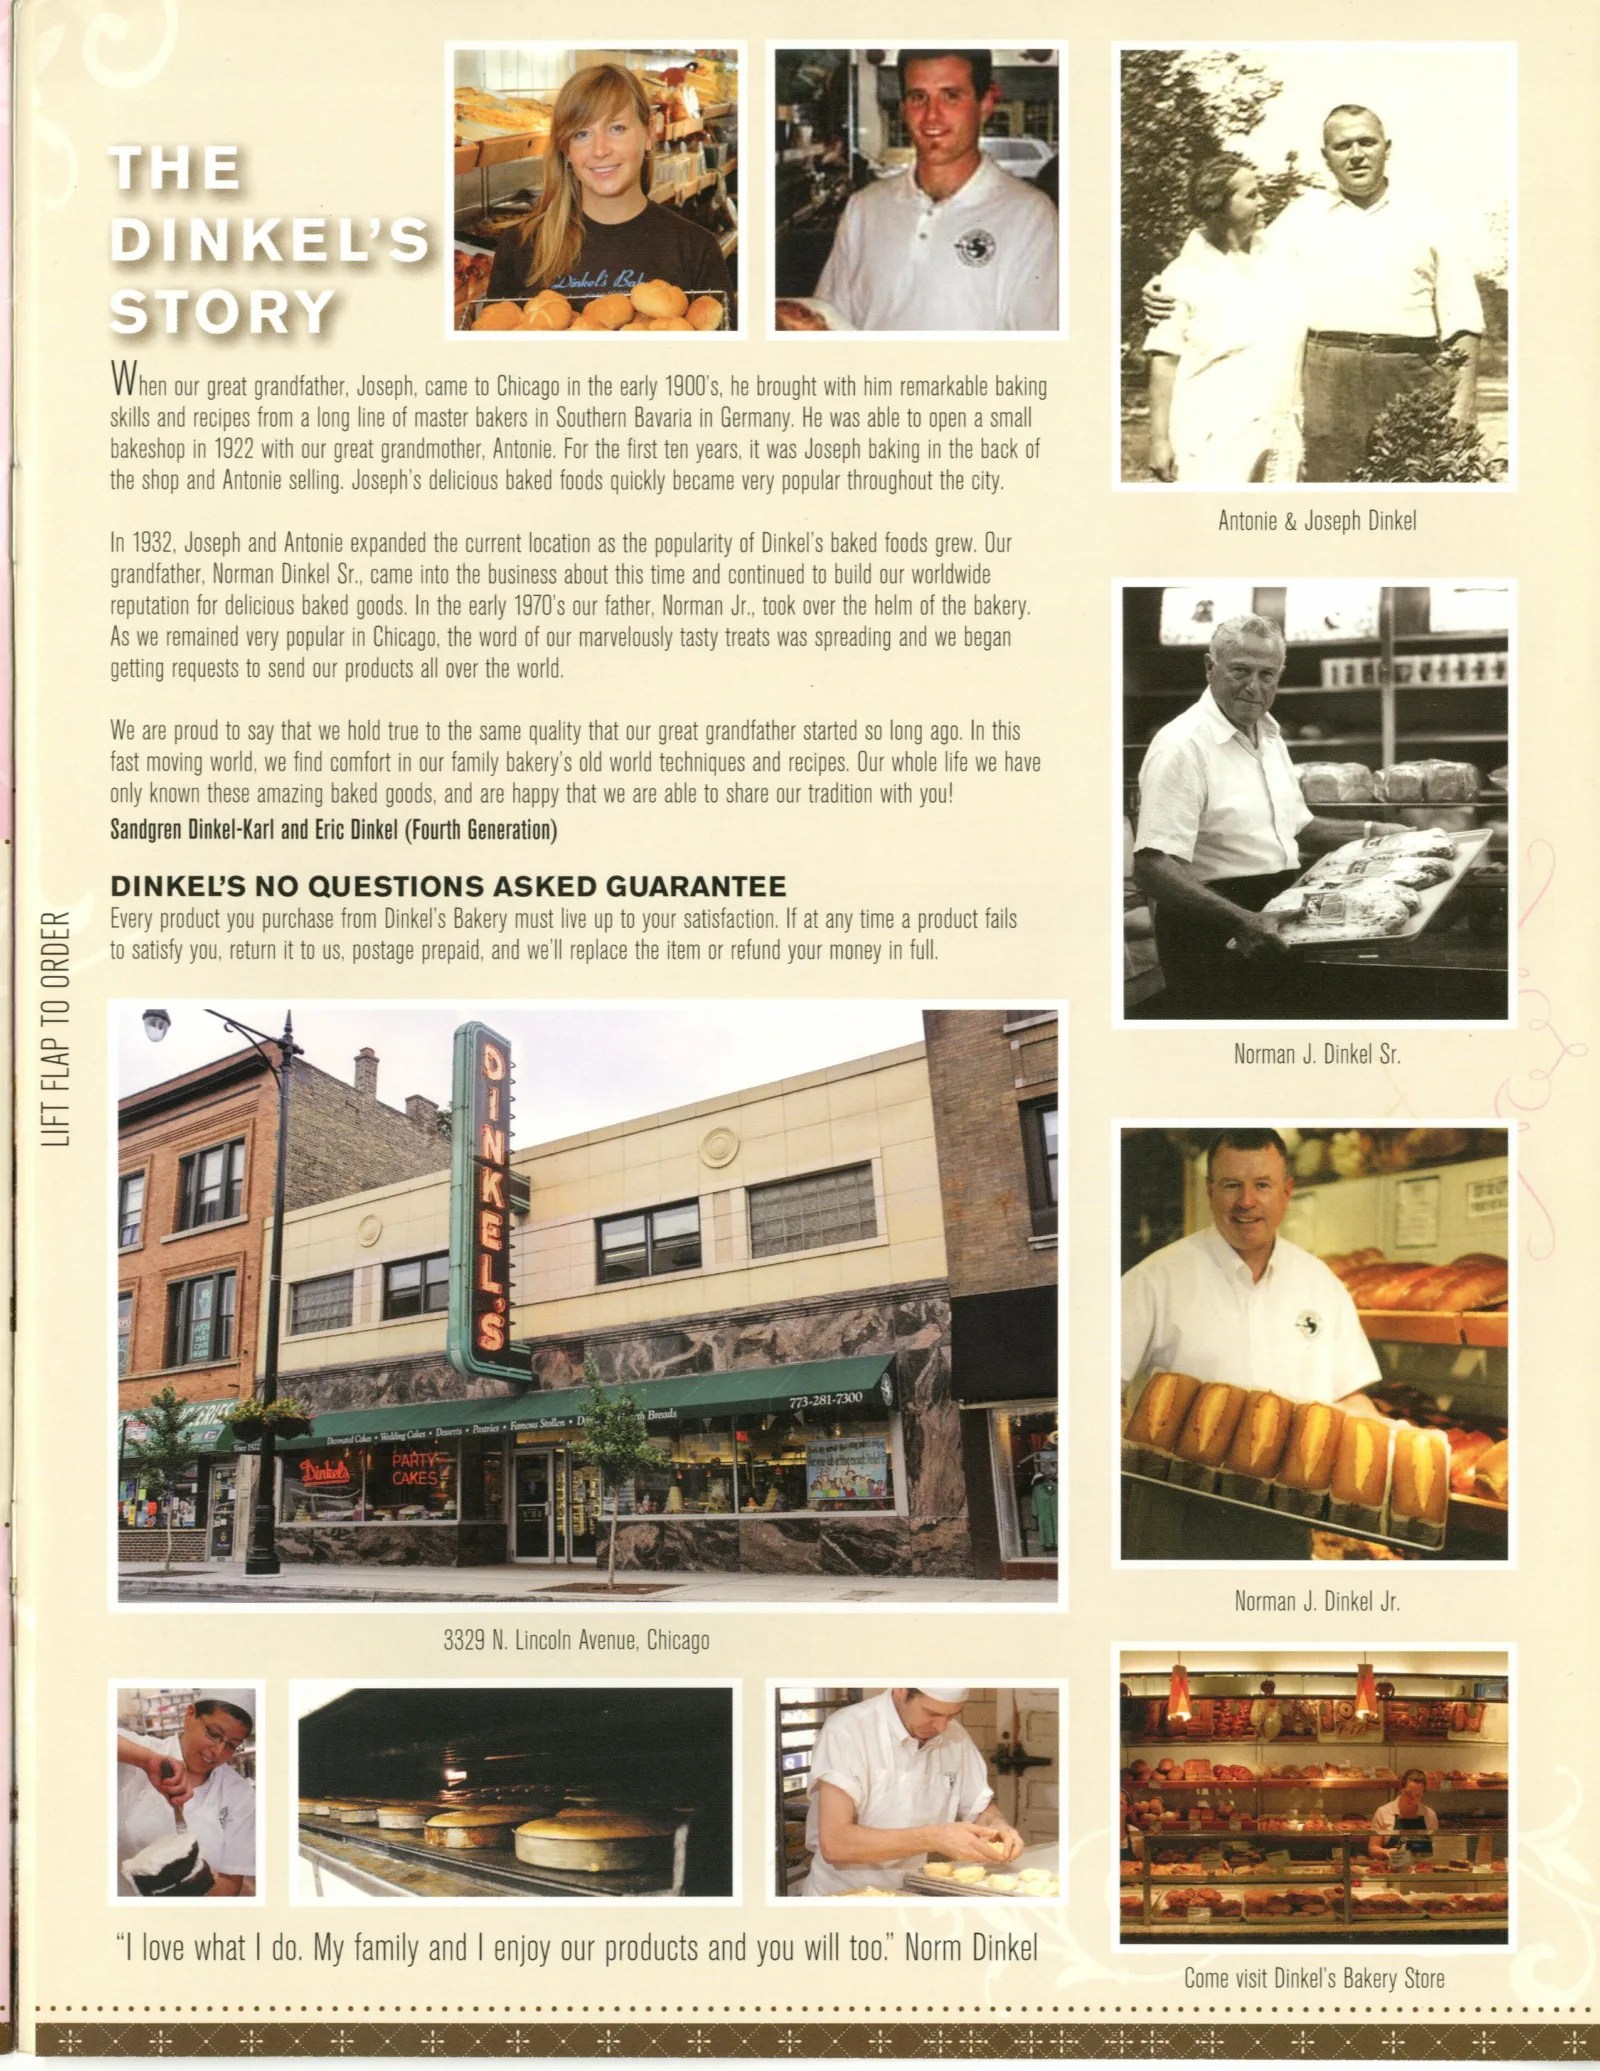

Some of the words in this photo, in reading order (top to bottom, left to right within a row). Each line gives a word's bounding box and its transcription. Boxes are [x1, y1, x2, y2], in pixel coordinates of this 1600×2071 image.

[109, 145, 239, 190] THE
[110, 217, 429, 263] DINKEL'S
[109, 288, 337, 335] STORY
[110, 359, 167, 397] When
[174, 379, 200, 397] our
[207, 376, 248, 401] great
[254, 374, 349, 401] grandfather,
[356, 374, 418, 401] Joseph,
[425, 379, 468, 397] came
[473, 376, 490, 397] to
[497, 373, 560, 401] Chicago
[567, 376, 581, 397] in
[587, 374, 613, 397] the
[619, 374, 658, 401] early
[730, 374, 750, 397] he
[756, 374, 818, 401] brought
[823, 374, 857, 397] with
[863, 374, 893, 397] him
[900, 374, 988, 397] remarkable
[995, 374, 1048, 401] baking
[1218, 508, 1278, 531] Antonie
[1284, 511, 1298, 532] &
[1304, 508, 1361, 536] Joseph
[1368, 508, 1417, 531] Dinkel
[110, 595, 190, 620] reputation
[196, 593, 219, 616] for
[224, 593, 295, 616] delicious
[301, 593, 349, 616] baked
[356, 593, 408, 621] goods.
[415, 593, 430, 616] In
[436, 593, 462, 616] the
[468, 593, 507, 621] early
[572, 599, 599, 616] our
[604, 593, 655, 618] father,
[662, 593, 724, 616] Norman
[730, 593, 755, 618] Jr.,
[761, 593, 796, 616] took
[802, 599, 837, 616] over
[842, 593, 867, 616] the
[874, 593, 913, 616] helm
[919, 593, 936, 616] of
[941, 593, 967, 616] the
[973, 593, 1031, 621] bakery.
[110, 781, 143, 808] only
[149, 781, 200, 804] known
[206, 781, 250, 804] these
[256, 783, 324, 808] amazing
[330, 781, 378, 804] baked
[385, 781, 437, 808] goods,
[444, 781, 473, 804] and
[479, 787, 505, 804] are
[512, 781, 560, 809] happy
[565, 781, 597, 804] that
[603, 787, 626, 804] we
[632, 787, 657, 804] are
[663, 781, 697, 804] able
[703, 783, 719, 804] to
[725, 781, 769, 804] share
[776, 787, 802, 804] our
[807, 781, 873, 804] tradition
[879, 781, 913, 804] with
[919, 781, 953, 809] you!
[110, 817, 182, 844] Sandgren
[188, 817, 275, 841] Dinkel-Karl
[280, 817, 309, 841] and
[315, 817, 345, 841] Eric
[350, 817, 398, 841] Dinkel
[404, 817, 461, 846] (Fourth
[467, 817, 558, 846] Generation)
[255, 874, 299, 898] NO
[307, 874, 485, 899] QUESTIONS
[492, 874, 598, 898] ASKED
[605, 874, 787, 898] GUARANTEE
[40, 911, 70, 988] ORDER
[109, 939, 125, 960] to
[131, 937, 184, 965] satisfy
[189, 943, 222, 965] you,
[229, 940, 277, 960] return
[283, 940, 294, 960] it
[299, 940, 316, 961] to
[322, 943, 345, 961] us,
[352, 940, 415, 965] postage
[421, 938, 484, 965] prepaid,
[491, 938, 520, 961] and
[570, 938, 628, 965] replace
[634, 937, 660, 961] the
[666, 940, 701, 961] item
[708, 943, 724, 961] or
[730, 938, 781, 961] refund
[787, 943, 823, 965] your
[829, 943, 883, 965] money
[888, 940, 903, 960] in
[909, 938, 939, 961] full.
[40, 1000, 70, 1028] TO
[40, 1037, 70, 1091] FLAP
[1234, 1042, 1296, 1065] Norman
[1302, 1042, 1317, 1065] J.
[1324, 1042, 1373, 1065] Dinkel
[1379, 1042, 1401, 1065] Sr.
[40, 1101, 70, 1146] LIFT
[789, 1391, 863, 1409] 773-281-7300
[326, 1433, 354, 1445] Decorated
[354, 1433, 372, 1443] Cakes
[380, 1430, 406, 1442] Wedding
[407, 1429, 426, 1440] Cakes
[435, 1427, 462, 1437] Desserts
[472, 1422, 500, 1434] Pastries
[510, 1420, 539, 1431] Famous
[540, 1416, 565, 1428] Stollen
[648, 1407, 678, 1420] Breads
[392, 1452, 438, 1468] PARTY
[392, 1471, 438, 1486] CAKES
[1235, 1589, 1296, 1612] Norman
[1303, 1589, 1317, 1612] J.
[1324, 1589, 1373, 1612] Dinkel
[1380, 1589, 1400, 1612] Jr.
[443, 1628, 485, 1651] 3329
[492, 1628, 508, 1651] N.
[515, 1628, 571, 1651] Lincoln
[578, 1628, 640, 1652] Avenue,
[647, 1628, 710, 1655] Chicago
[143, 1931, 185, 1962] love
[193, 1931, 246, 1962] what
[256, 1931, 261, 1961] I
[272, 1931, 303, 1962] do.
[314, 1931, 345, 1968] My
[353, 1931, 420, 1968] family
[428, 1931, 467, 1962] and
[478, 1931, 483, 1962] I
[494, 1934, 552, 1968] enjoy
[560, 1939, 596, 1962] our
[605, 1931, 699, 1968] products
[708, 1931, 747, 1962] and
[756, 1939, 794, 1968] you
[804, 1931, 840, 1962] will
[905, 1931, 962, 1962] Norm
[973, 1931, 1038, 1962] Dinkel
[1184, 1966, 1229, 1989] Come
[1235, 1968, 1268, 1989] visit
[1343, 1966, 1398, 1994] Bakery
[1404, 1966, 1445, 1989] Store
